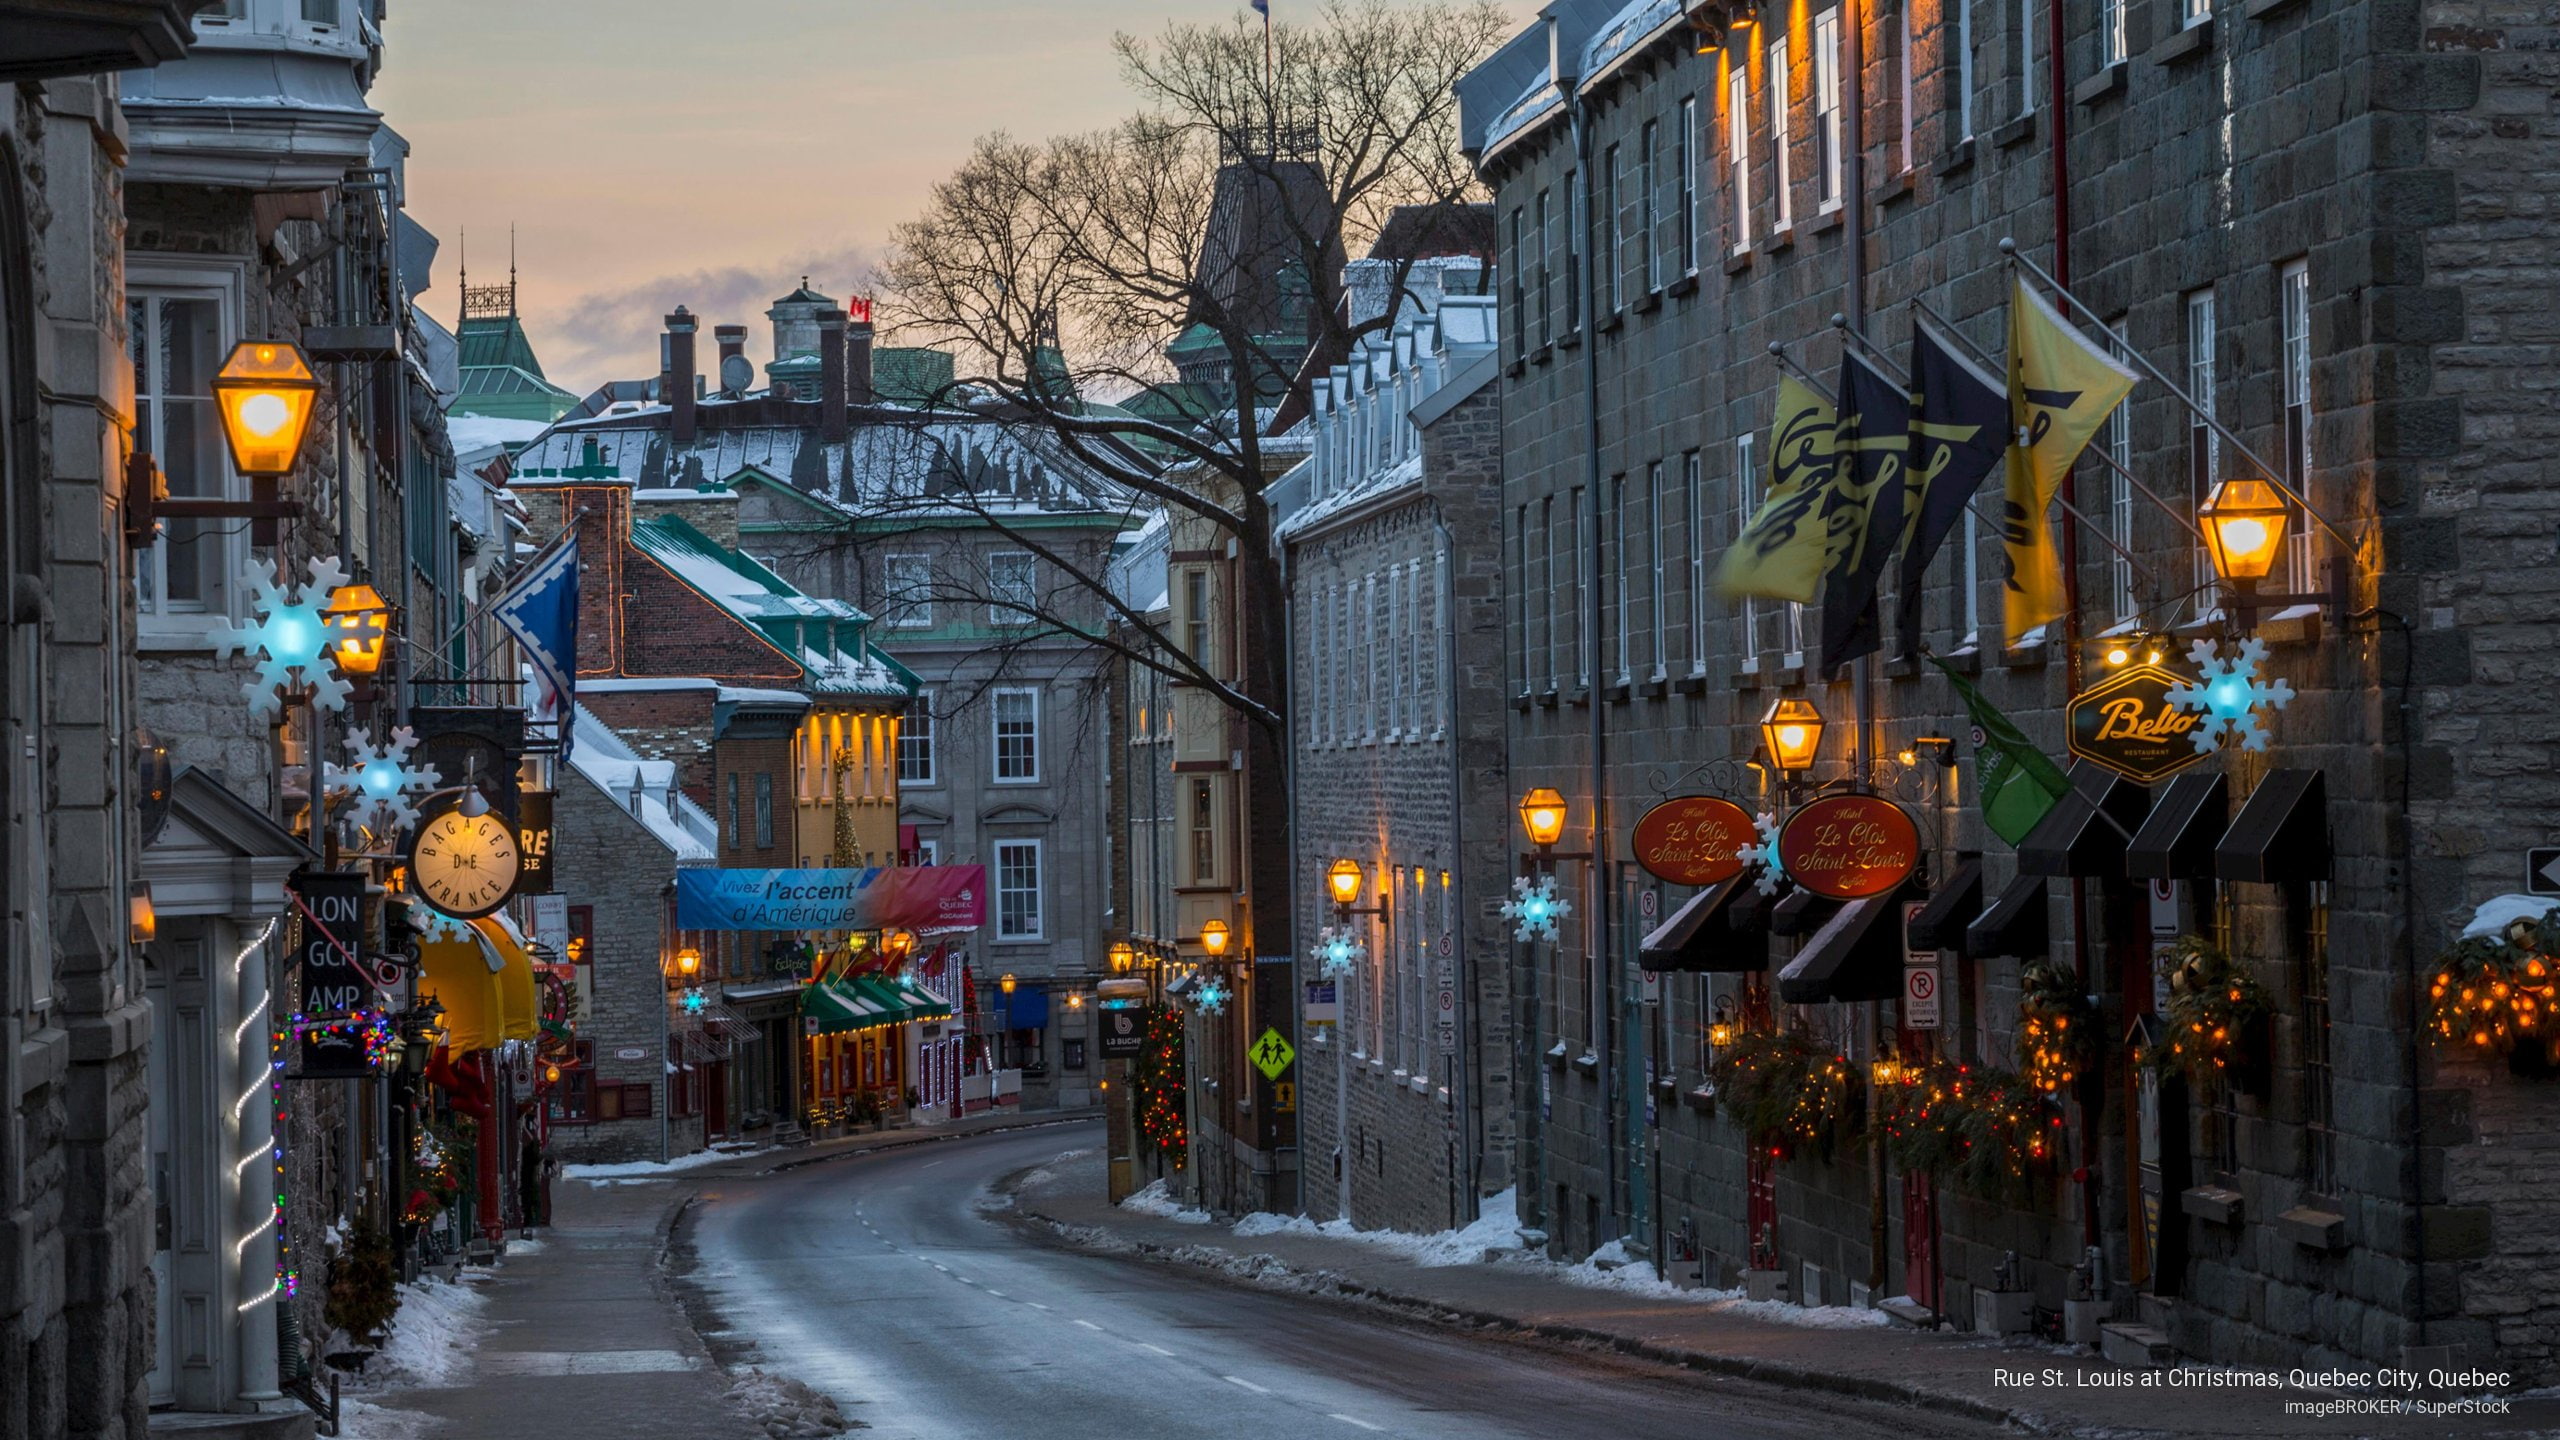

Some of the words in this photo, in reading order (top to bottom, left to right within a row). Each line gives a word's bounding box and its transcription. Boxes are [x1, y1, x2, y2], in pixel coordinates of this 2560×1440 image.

[421, 817, 510, 858] BAGAGES
[1665, 821, 1689, 842] Le
[1695, 820, 1728, 841] Clos
[1815, 823, 1842, 847] Le
[1848, 822, 1887, 846] Clos
[453, 854, 477, 869] DE
[1649, 841, 1742, 864] Saint-Loui
[428, 879, 502, 907] FRANCE
[722, 880, 761, 893] Vivez
[766, 882, 855, 900] l'accent
[310, 896, 357, 922] LON
[733, 904, 856, 926] d'Amérique
[309, 941, 357, 966] GCH
[307, 986, 359, 1011] AMP
